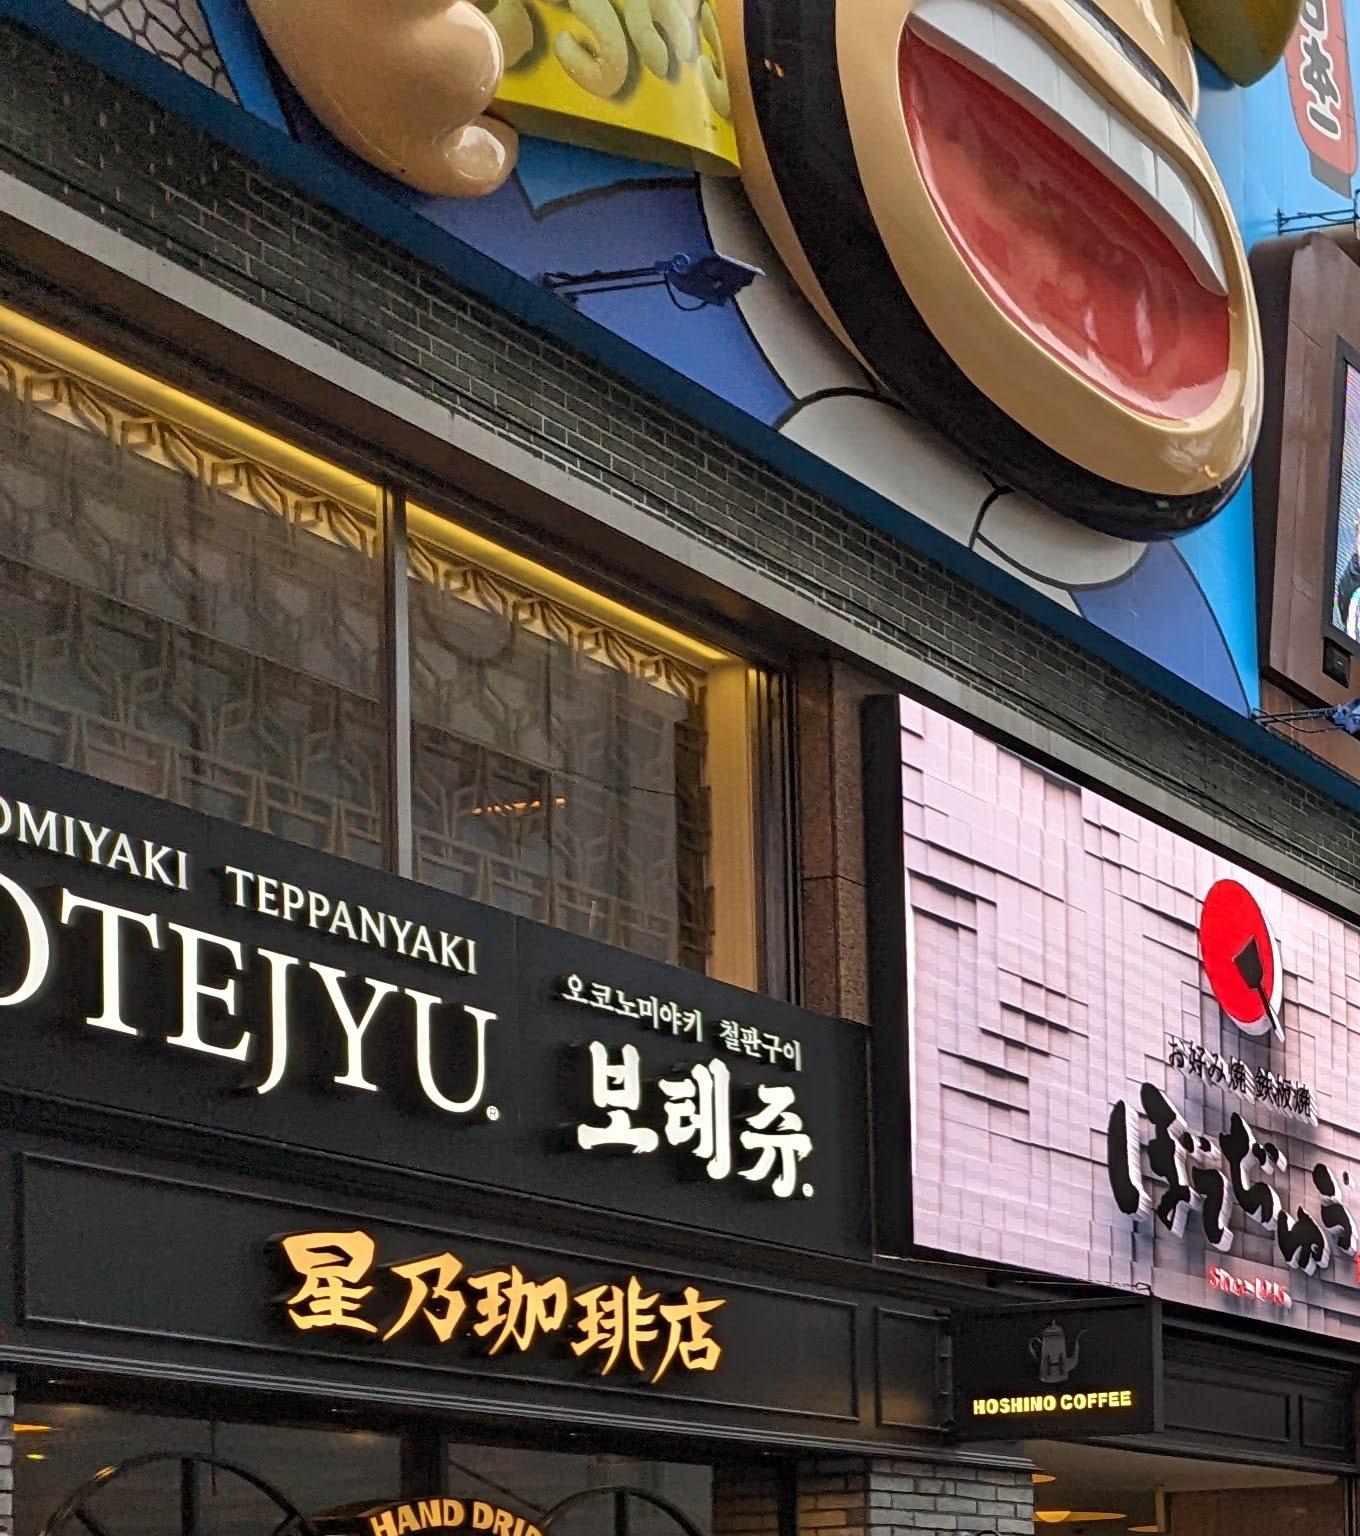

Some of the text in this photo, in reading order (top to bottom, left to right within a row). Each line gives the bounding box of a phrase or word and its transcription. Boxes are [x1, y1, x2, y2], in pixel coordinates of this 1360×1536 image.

[225, 866, 479, 975] TEPPANYAKI
[563, 973, 803, 1071] 오코노미야키 철판구이
[578, 1040, 813, 1198] 보테쥬
[281, 1229, 727, 1383] 星乃珈琲店
[973, 1390, 1132, 1416] HOSHINO COFFEE
